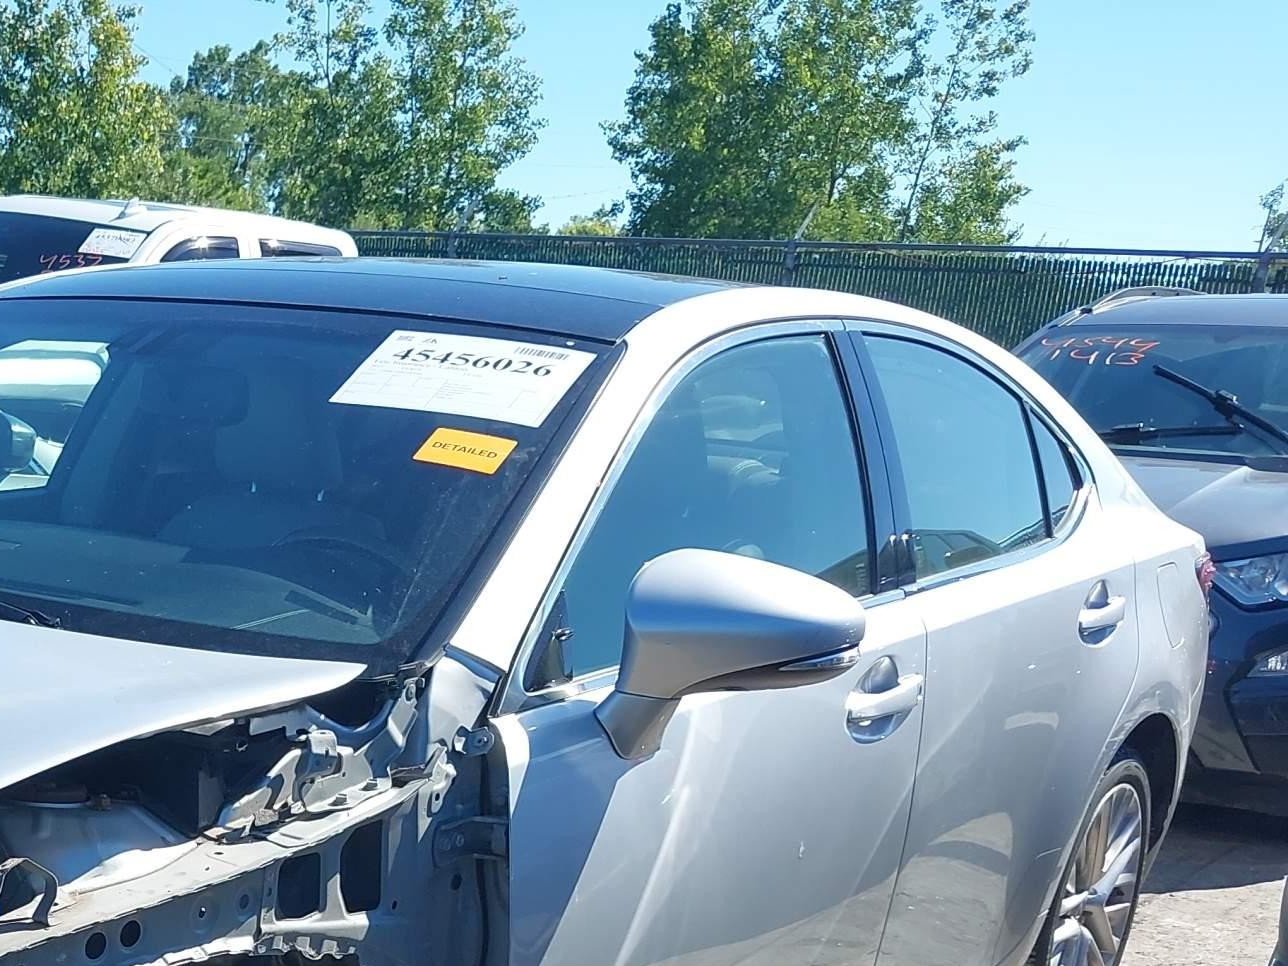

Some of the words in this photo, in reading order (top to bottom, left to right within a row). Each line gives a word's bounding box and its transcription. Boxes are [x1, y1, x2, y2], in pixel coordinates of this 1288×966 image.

[392, 347, 552, 377] 45456026
[1050, 349, 1145, 365] 1413
[431, 440, 499, 460] DETAILED
